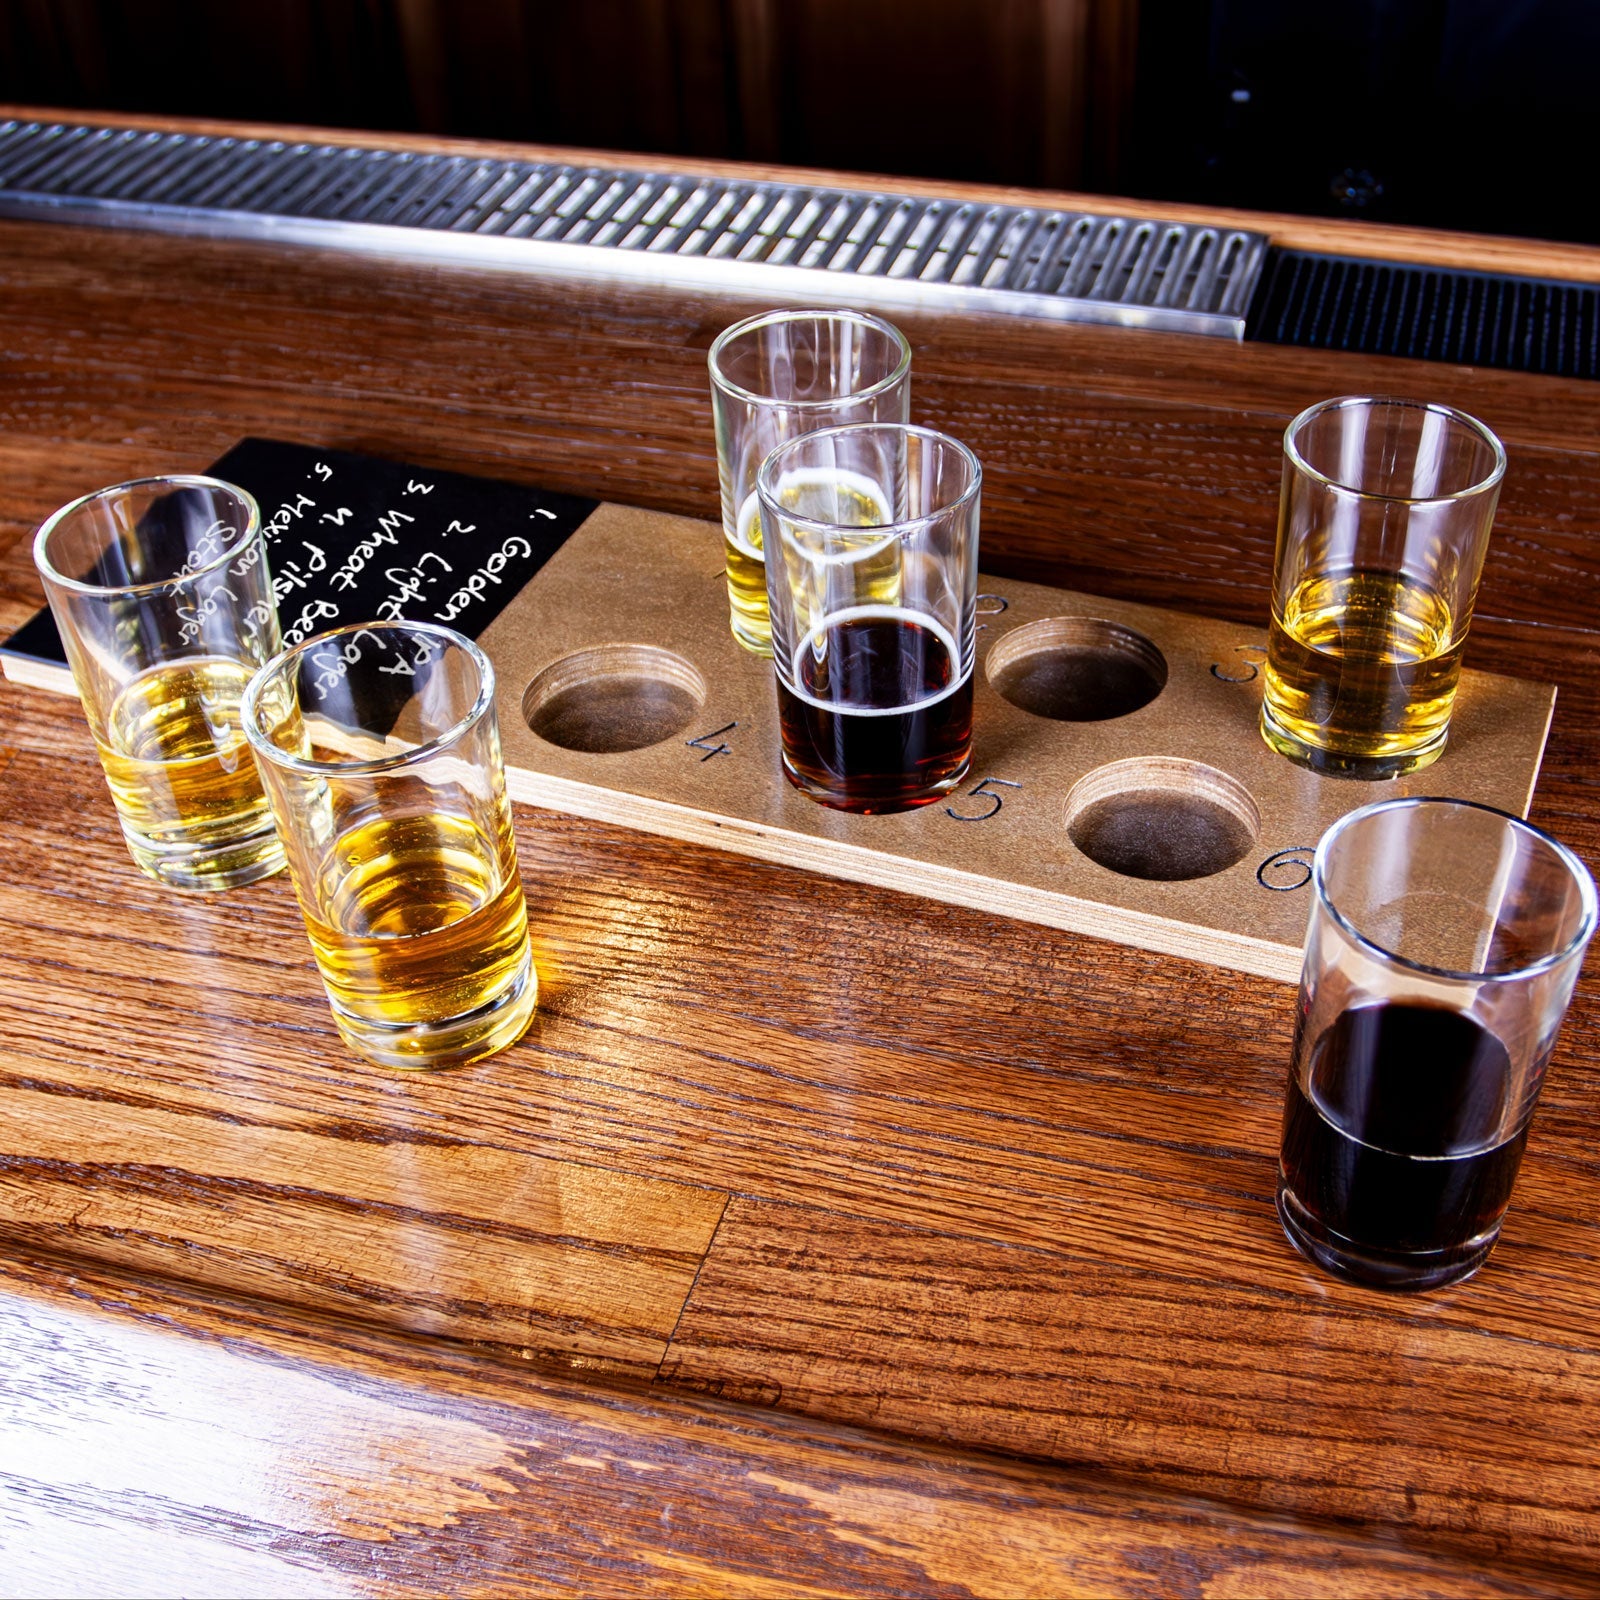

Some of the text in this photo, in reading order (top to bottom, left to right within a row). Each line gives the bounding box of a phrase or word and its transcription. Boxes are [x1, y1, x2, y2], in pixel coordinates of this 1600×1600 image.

[401, 479, 434, 495] 3.
[163, 520, 237, 598] Stout
[176, 462, 333, 645] 5. Mexican Lager
[243, 541, 327, 639] Pilsner
[330, 510, 415, 592] Wheat
[433, 536, 532, 621] Golden
[311, 519, 476, 701] 2. Light Lager
[378, 632, 441, 676] IPA
[685, 722, 738, 761] 4
[945, 777, 1023, 821] 5
[1256, 846, 1316, 892] 6
